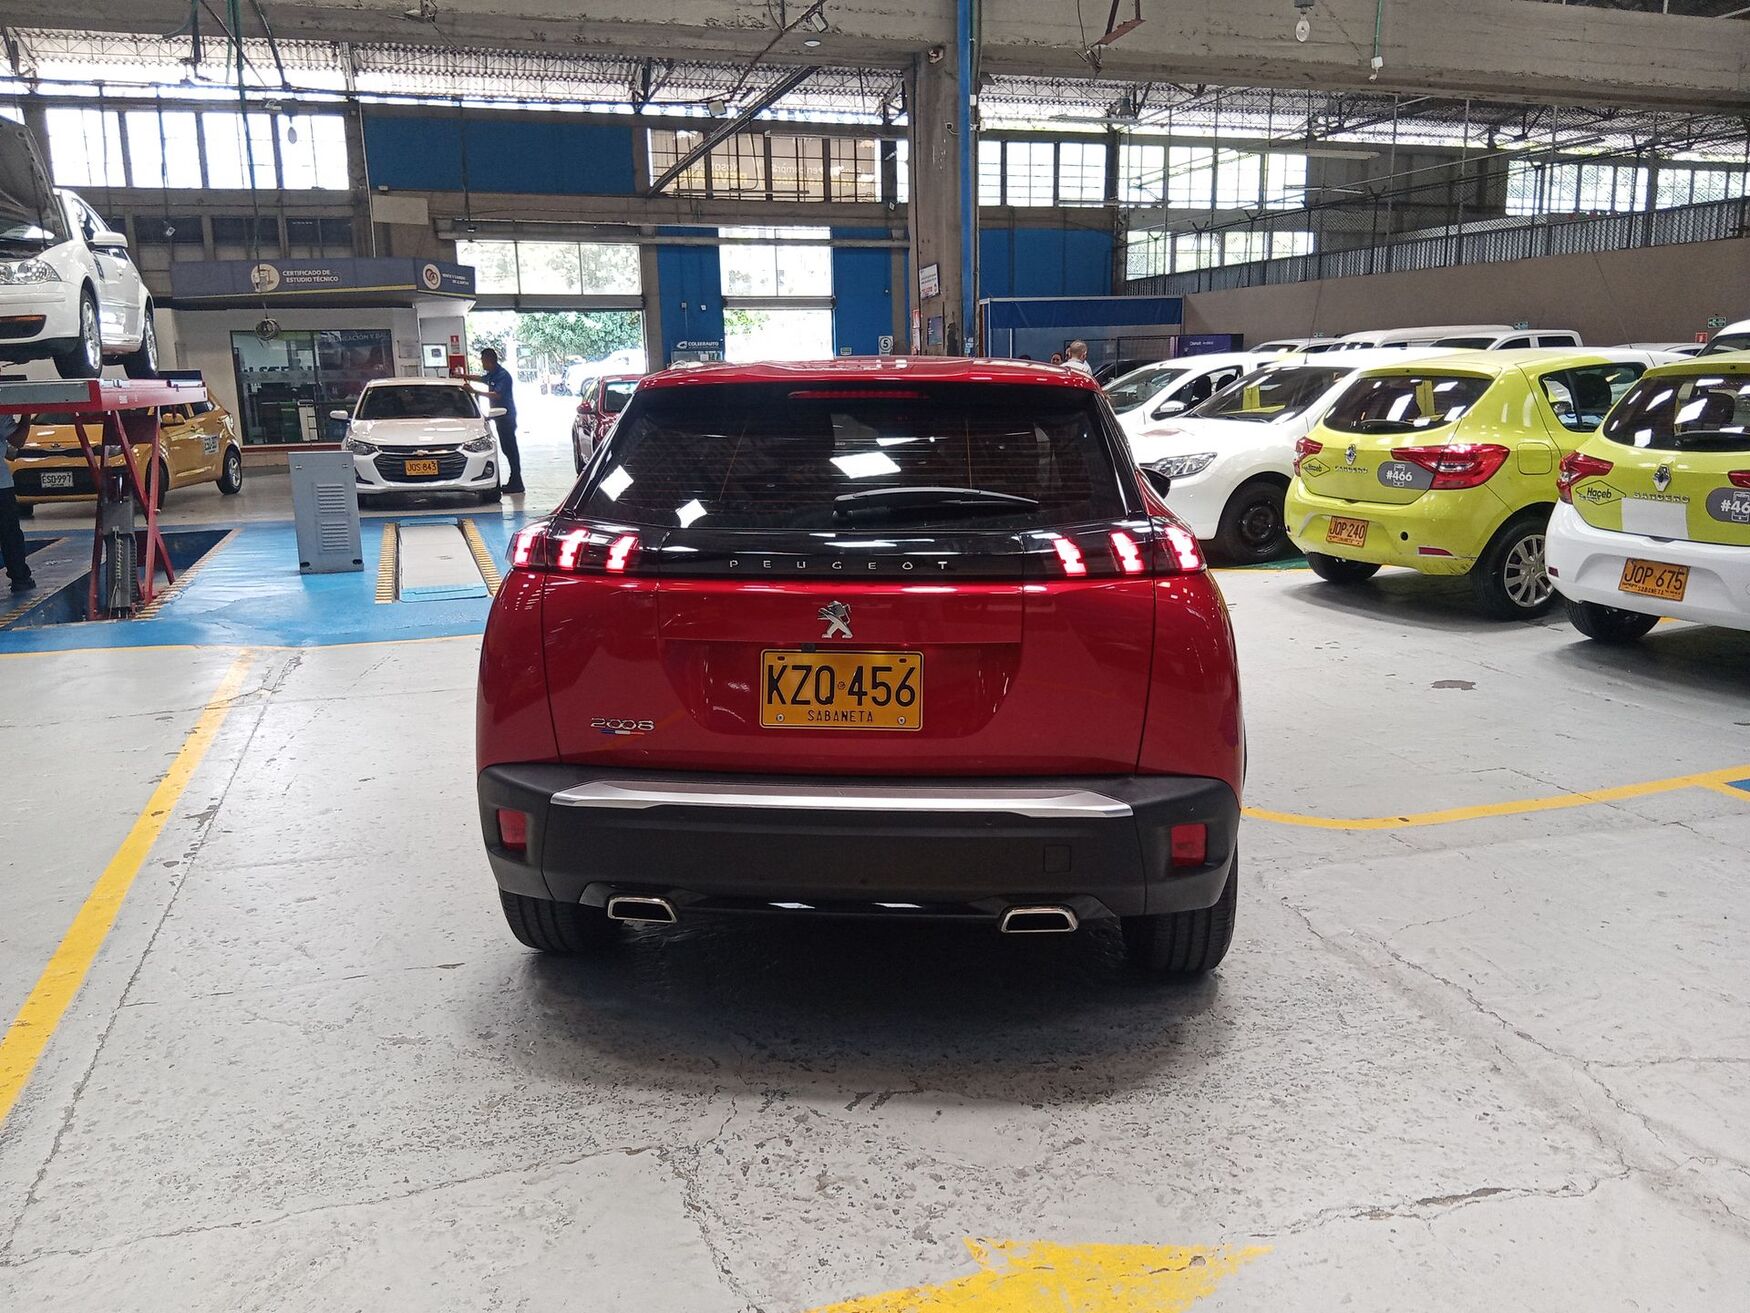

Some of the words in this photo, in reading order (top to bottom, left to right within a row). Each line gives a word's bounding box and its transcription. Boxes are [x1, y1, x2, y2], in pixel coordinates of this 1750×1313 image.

[883, 340, 889, 348] 5
[422, 463, 437, 471] 843
[1386, 470, 1413, 481] #466
[1347, 523, 1366, 539] 240
[729, 560, 948, 570] PEUGEOT
[1624, 565, 1653, 584] JQP
[1655, 569, 1685, 591] 675
[767, 664, 835, 705] KZQ
[848, 666, 916, 707] 456
[807, 709, 873, 722] SABANETA
[590, 717, 655, 731] 2008
